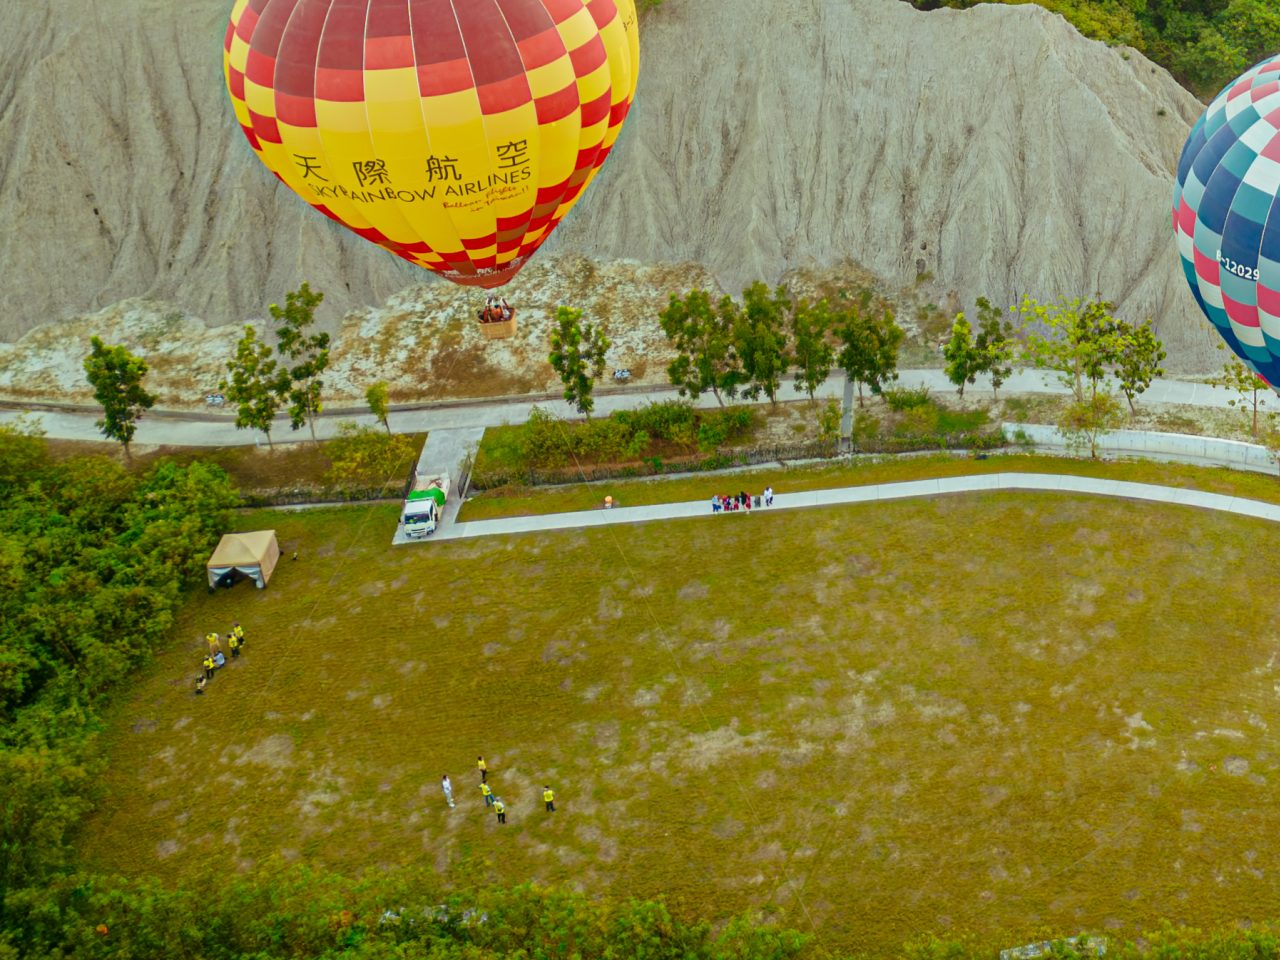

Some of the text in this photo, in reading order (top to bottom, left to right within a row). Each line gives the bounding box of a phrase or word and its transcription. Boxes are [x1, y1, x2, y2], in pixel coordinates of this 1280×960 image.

[293, 139, 531, 187] 天際航空
[308, 167, 531, 203] SKYRAINBOW AIRLINES
[1216, 249, 1260, 280] B-12029
